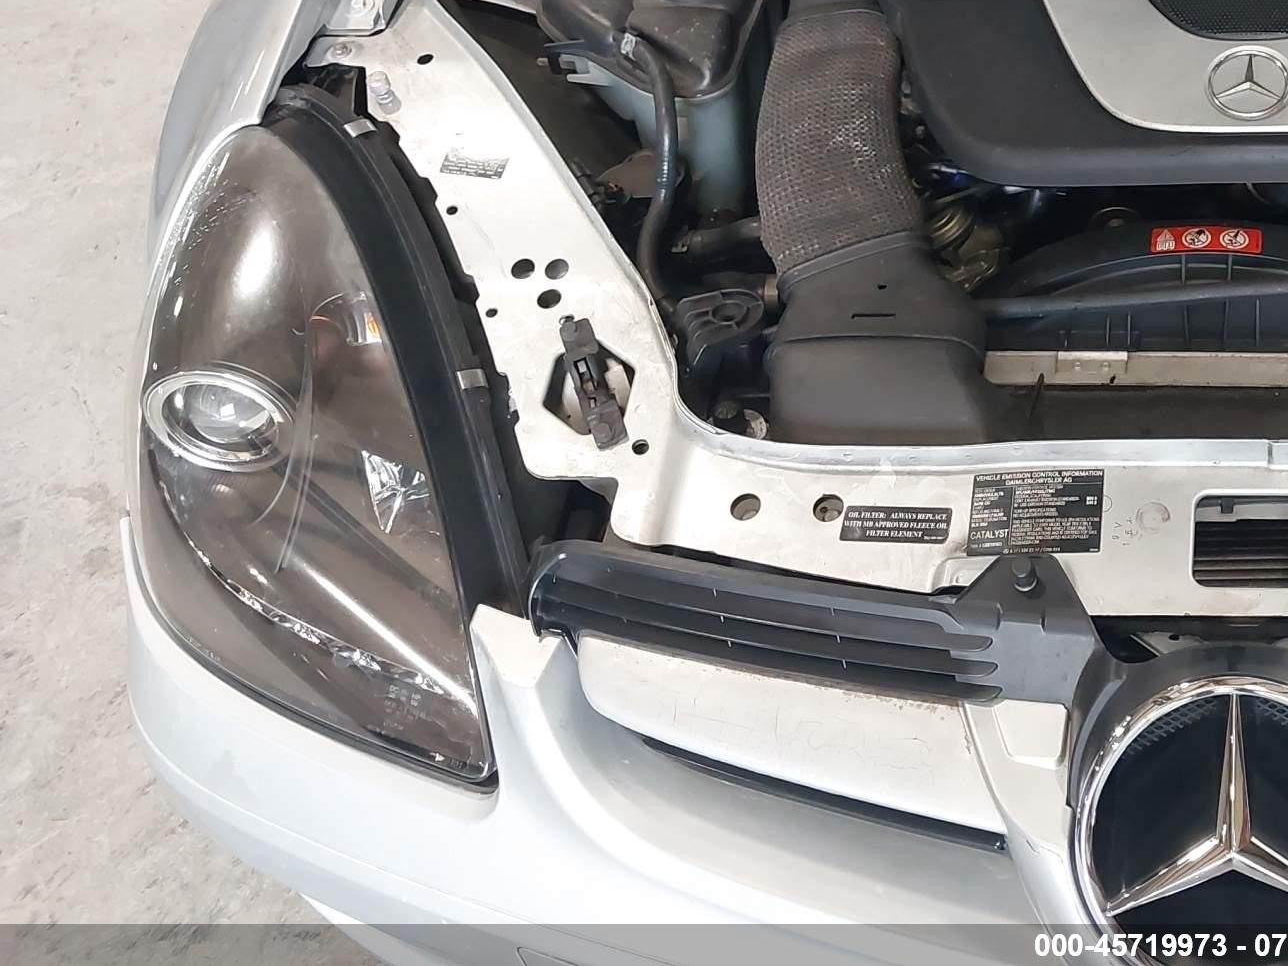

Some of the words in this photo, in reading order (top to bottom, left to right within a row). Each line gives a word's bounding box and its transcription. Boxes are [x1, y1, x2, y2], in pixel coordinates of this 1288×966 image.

[976, 474, 1000, 482] VEHICLE
[1032, 471, 1060, 479] CONTROL
[1061, 470, 1103, 478] INFORMATION
[1006, 477, 1062, 485] DAIMLERCHRYSLER
[890, 512, 916, 520] ALWAYS
[970, 529, 1009, 540] CATALYST
